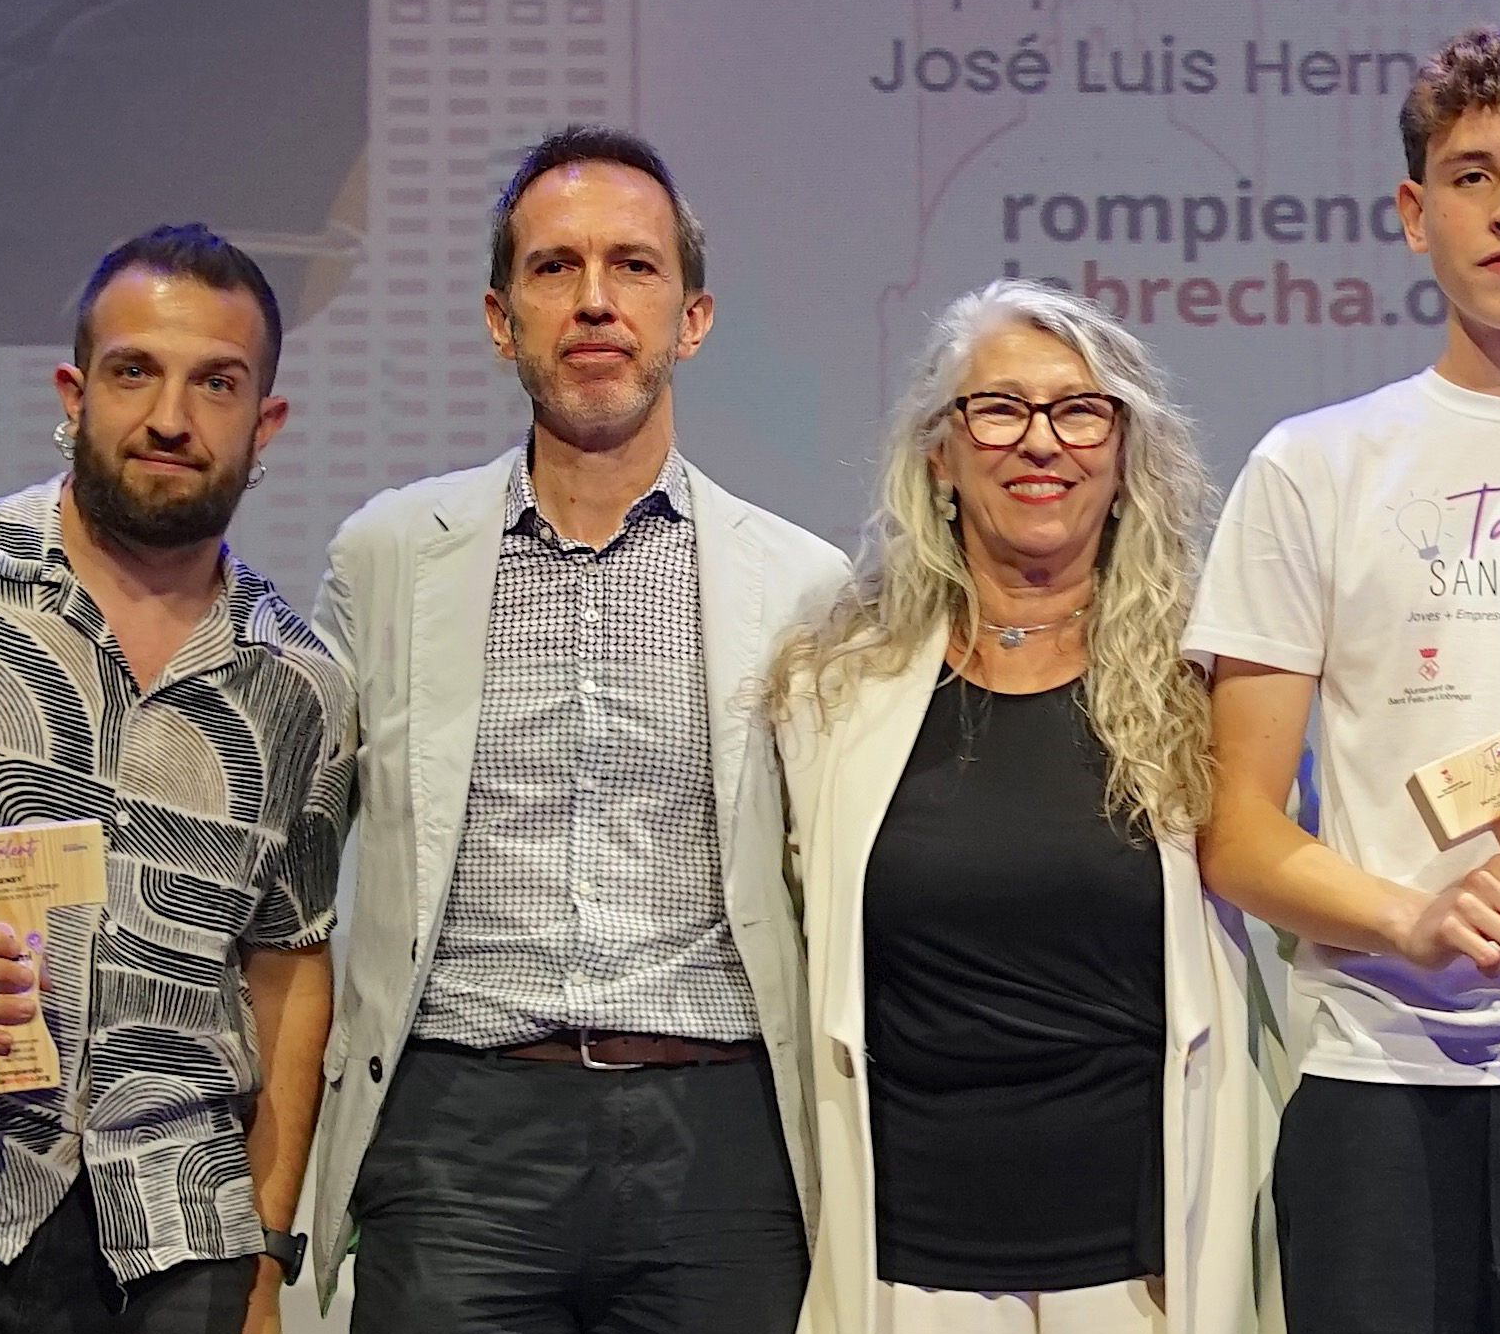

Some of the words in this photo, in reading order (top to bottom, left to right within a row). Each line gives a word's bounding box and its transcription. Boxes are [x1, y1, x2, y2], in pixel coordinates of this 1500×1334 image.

[868, 33, 1053, 96] José
[1075, 35, 1219, 96] Luis
[1407, 610, 1441, 623] Joves
